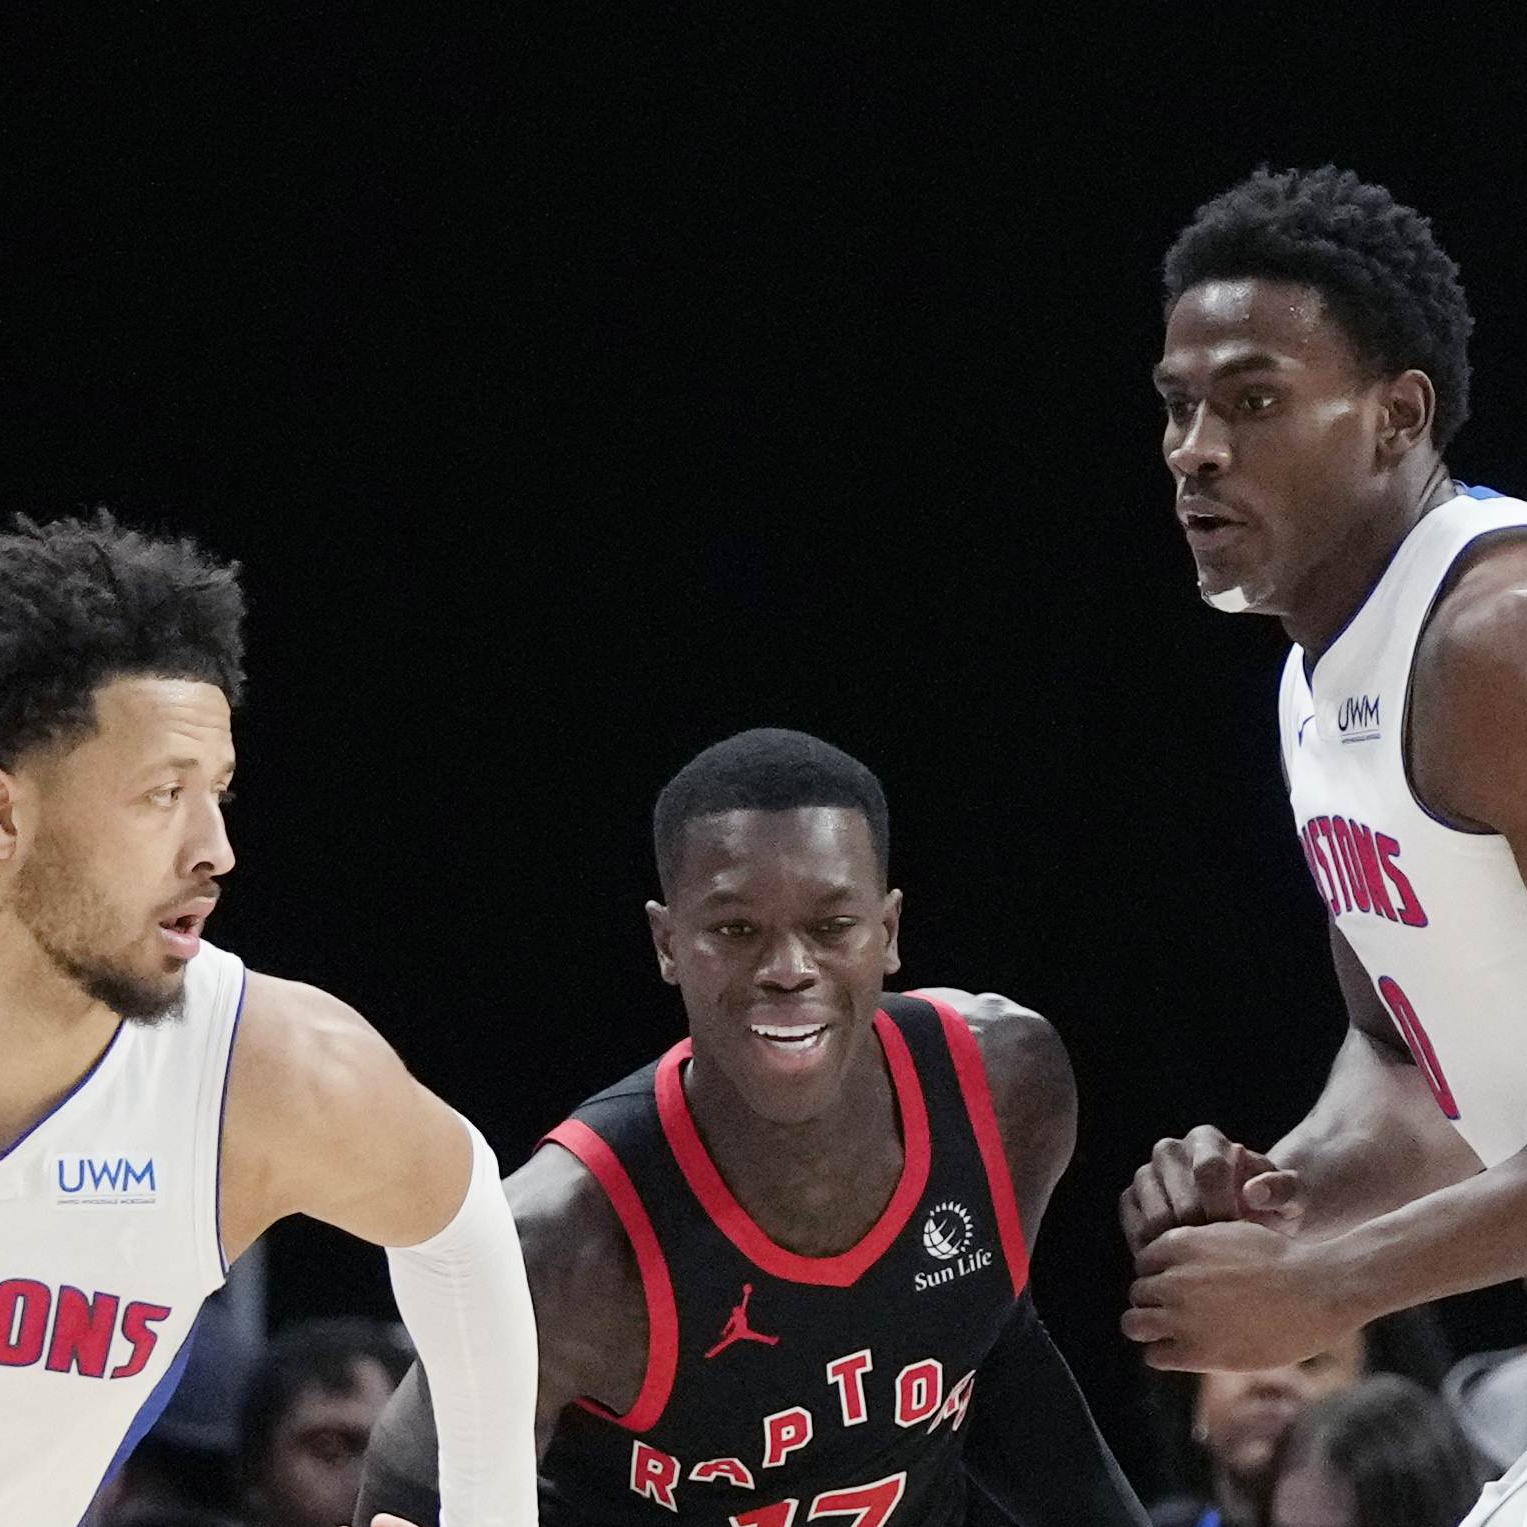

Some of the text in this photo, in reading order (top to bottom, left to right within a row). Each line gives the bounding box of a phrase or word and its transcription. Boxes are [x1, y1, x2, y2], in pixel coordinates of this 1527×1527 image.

[1337, 694, 1380, 731] UWM
[58, 1157, 156, 1193] UWM
[914, 1248, 993, 1292] Sun Life
[629, 1348, 977, 1513] RAPTOR
